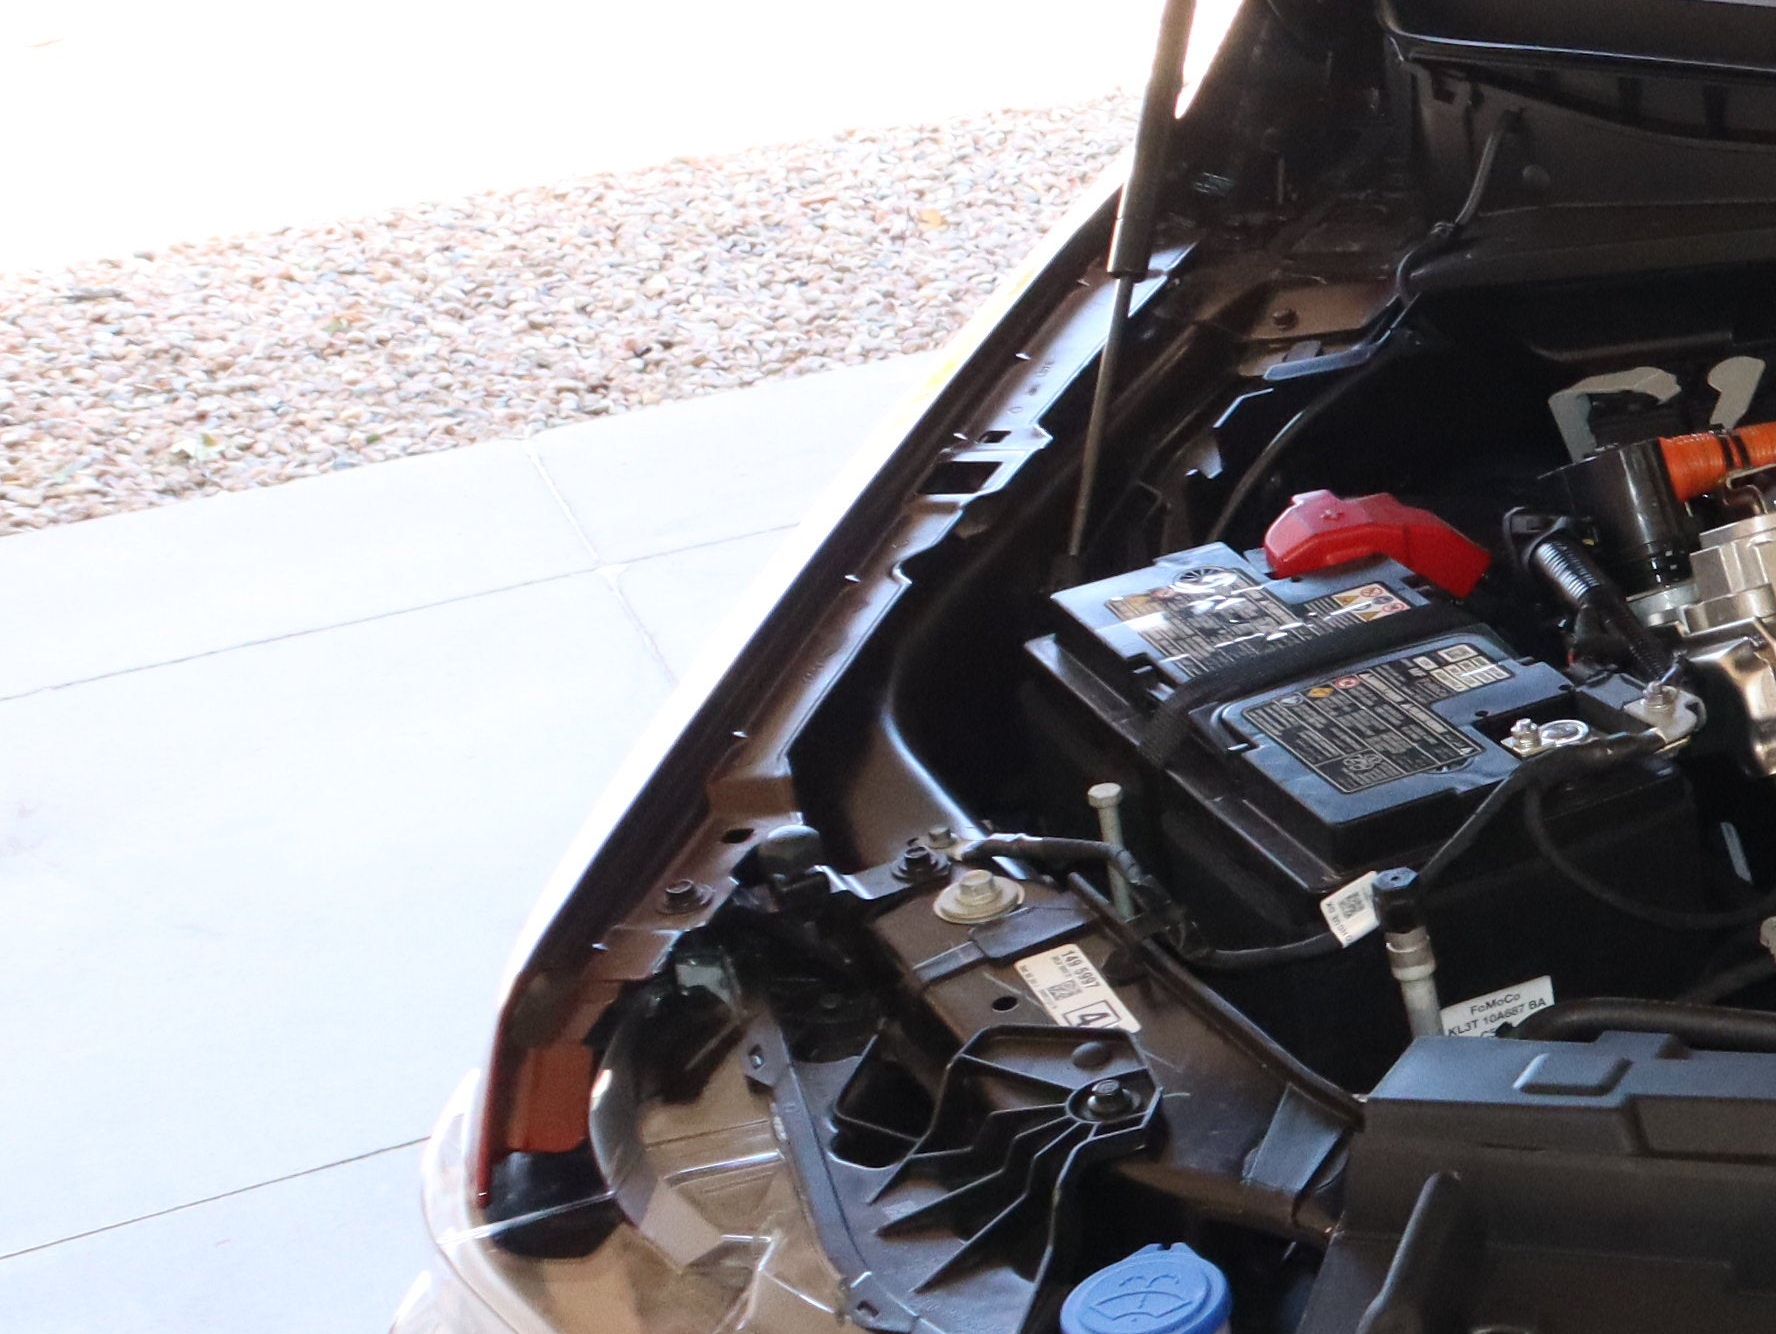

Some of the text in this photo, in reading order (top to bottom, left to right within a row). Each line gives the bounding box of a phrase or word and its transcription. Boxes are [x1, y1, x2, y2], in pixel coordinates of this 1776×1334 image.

[1470, 993, 1521, 1015] FoMoCo
[1077, 1012, 1112, 1026] 4
[1447, 1019, 1478, 1037] KL3T
[1528, 997, 1547, 1010] BA
